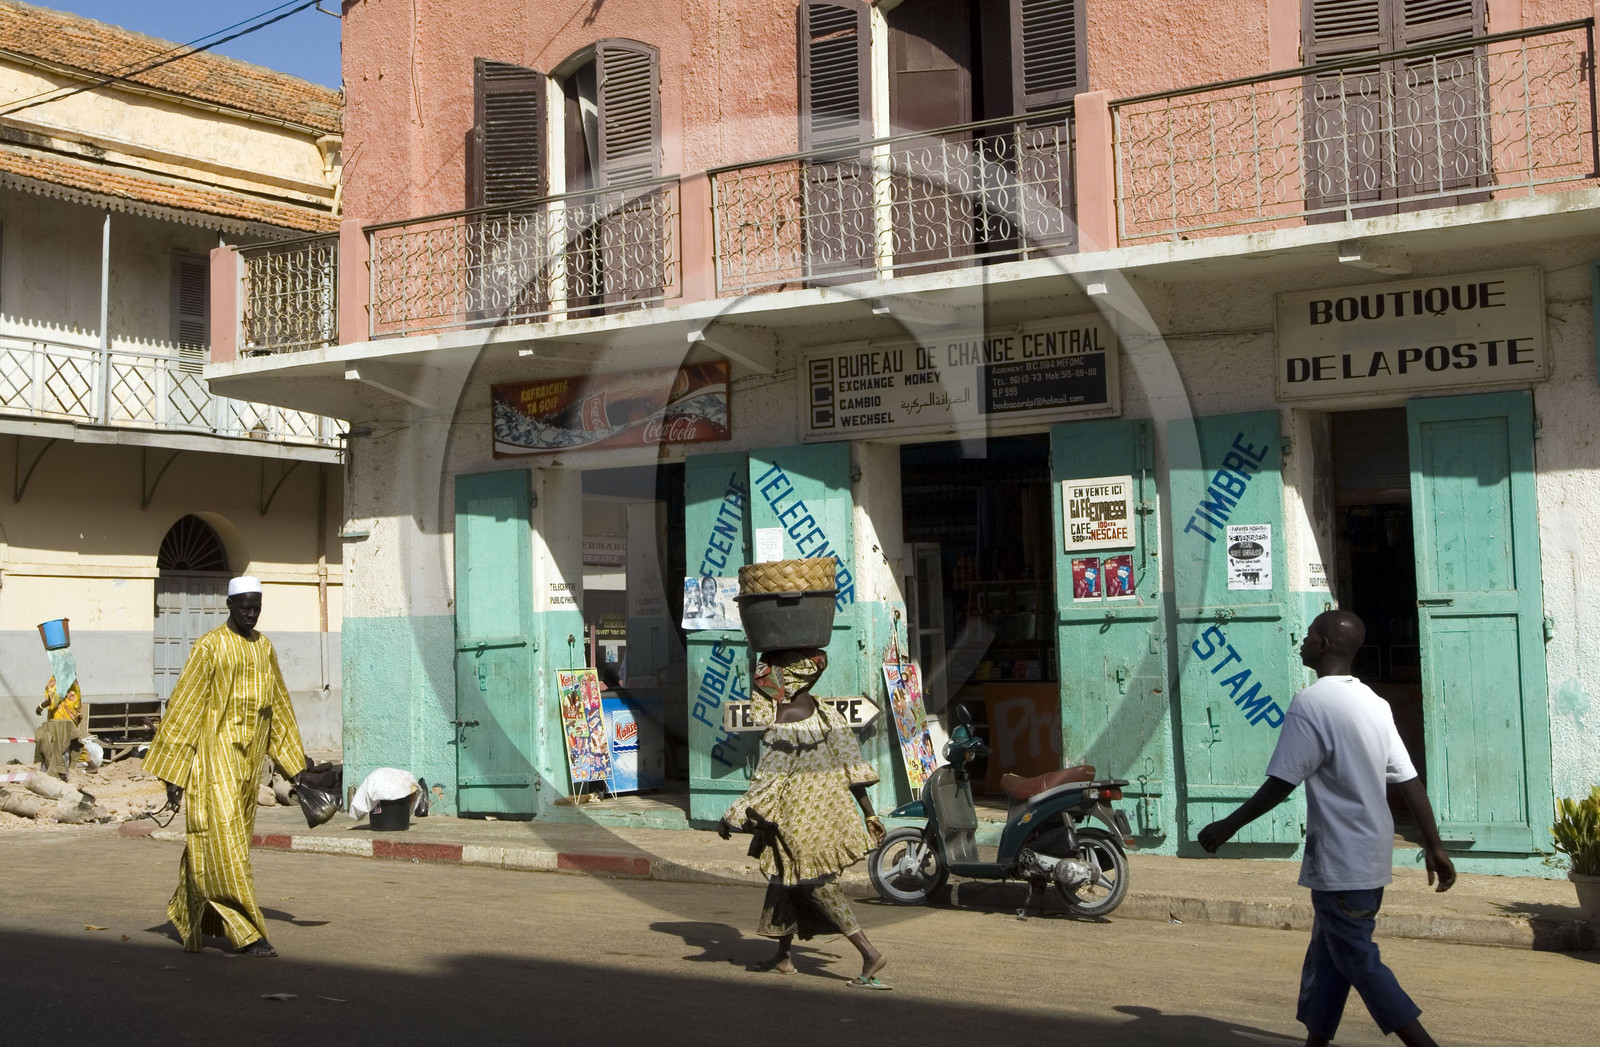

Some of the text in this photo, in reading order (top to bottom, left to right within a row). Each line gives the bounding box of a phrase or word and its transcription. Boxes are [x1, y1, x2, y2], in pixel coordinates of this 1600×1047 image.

[1310, 280, 1506, 325] BOUTIQUE
[838, 327, 1105, 378] BUREAU DE CHANGE CENTRAL
[1286, 337, 1535, 383] DE LA POSTE
[838, 371, 942, 393] EXCHANGE MONEY
[527, 397, 559, 415] TA SOIF
[839, 396, 881, 411] CAMBIO
[840, 411, 895, 428] WECHSEL
[643, 415, 702, 443] Coca-Cola
[1074, 486, 1122, 498] EN VENTE ICI
[1183, 431, 1269, 543] TIMBRE
[755, 460, 855, 612] TELECENRE
[692, 640, 735, 728] PUBLIC
[1192, 625, 1286, 729] STAMP
[616, 722, 638, 740] Kalise
